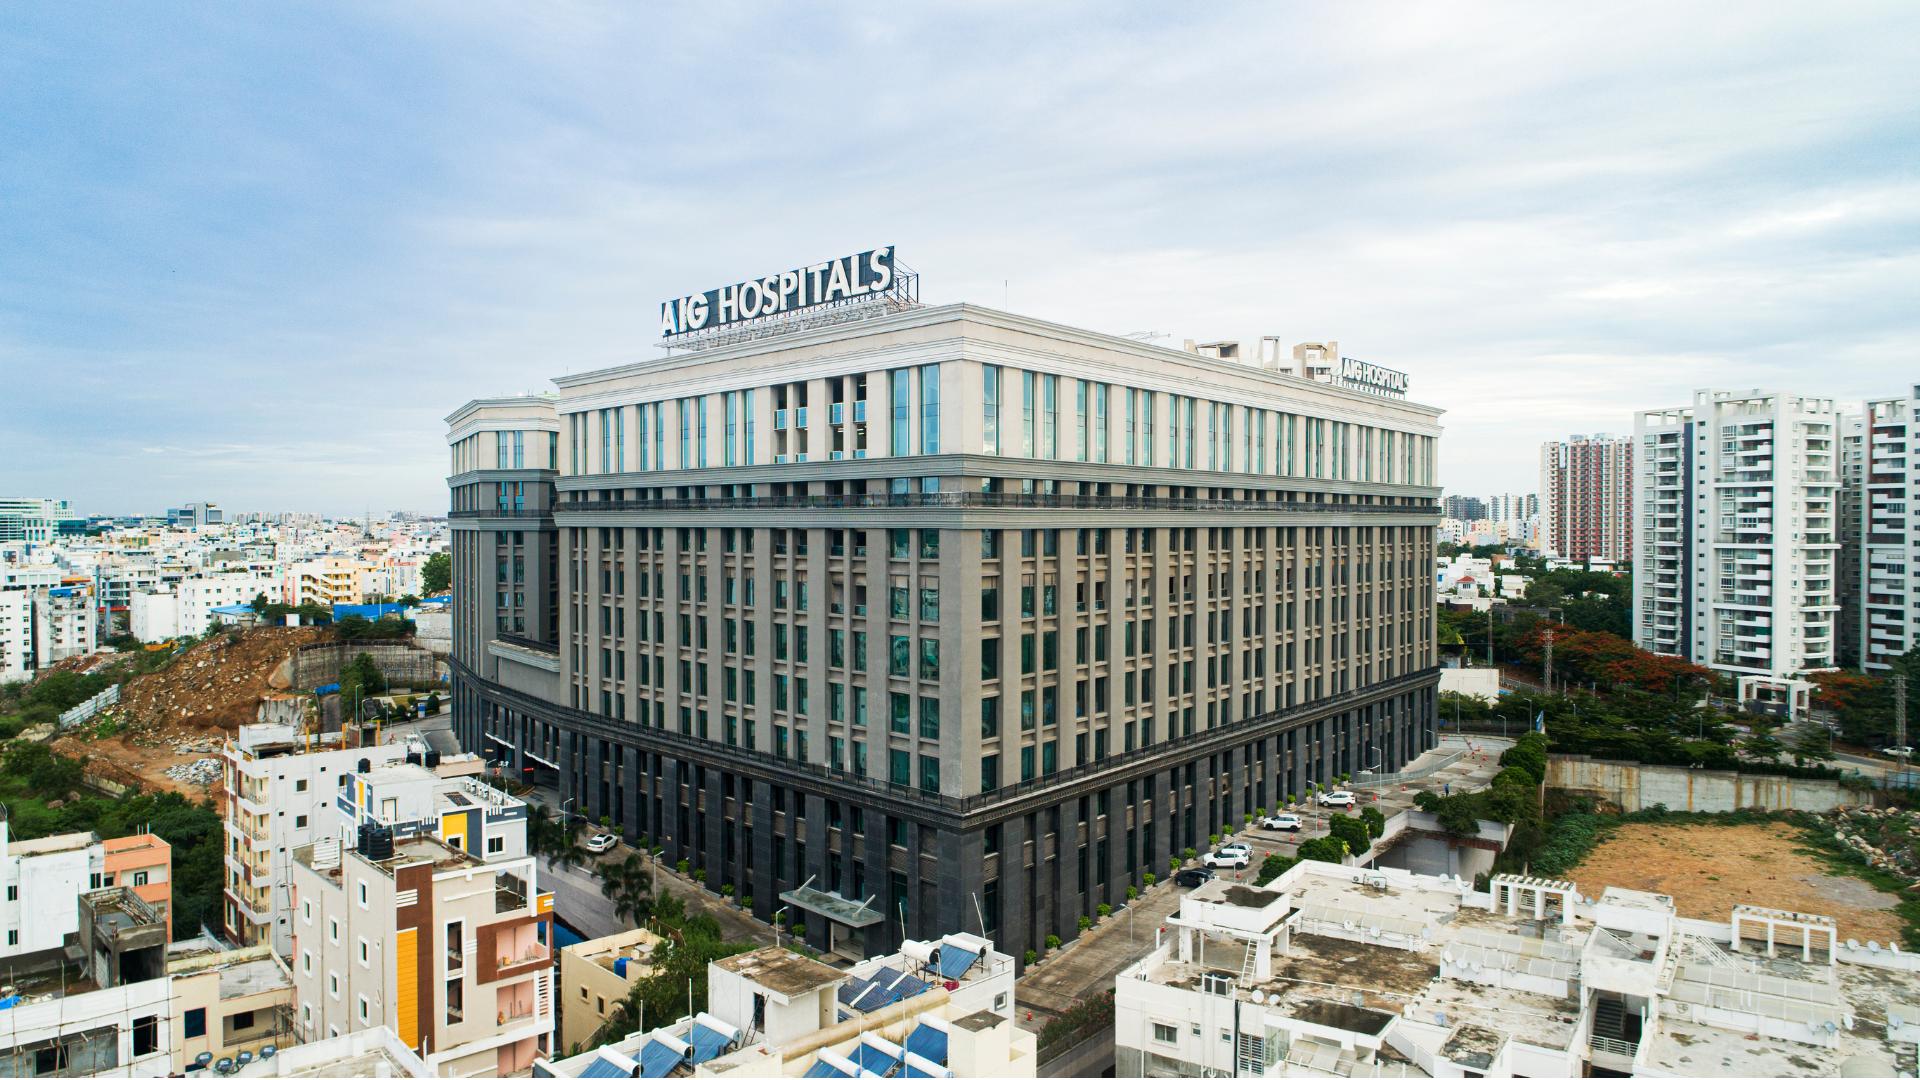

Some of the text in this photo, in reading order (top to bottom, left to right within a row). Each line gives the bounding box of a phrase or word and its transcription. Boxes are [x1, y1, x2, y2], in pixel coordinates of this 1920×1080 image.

[662, 247, 890, 337] AIG HOSPITALS
[1343, 359, 1363, 381] AIG
